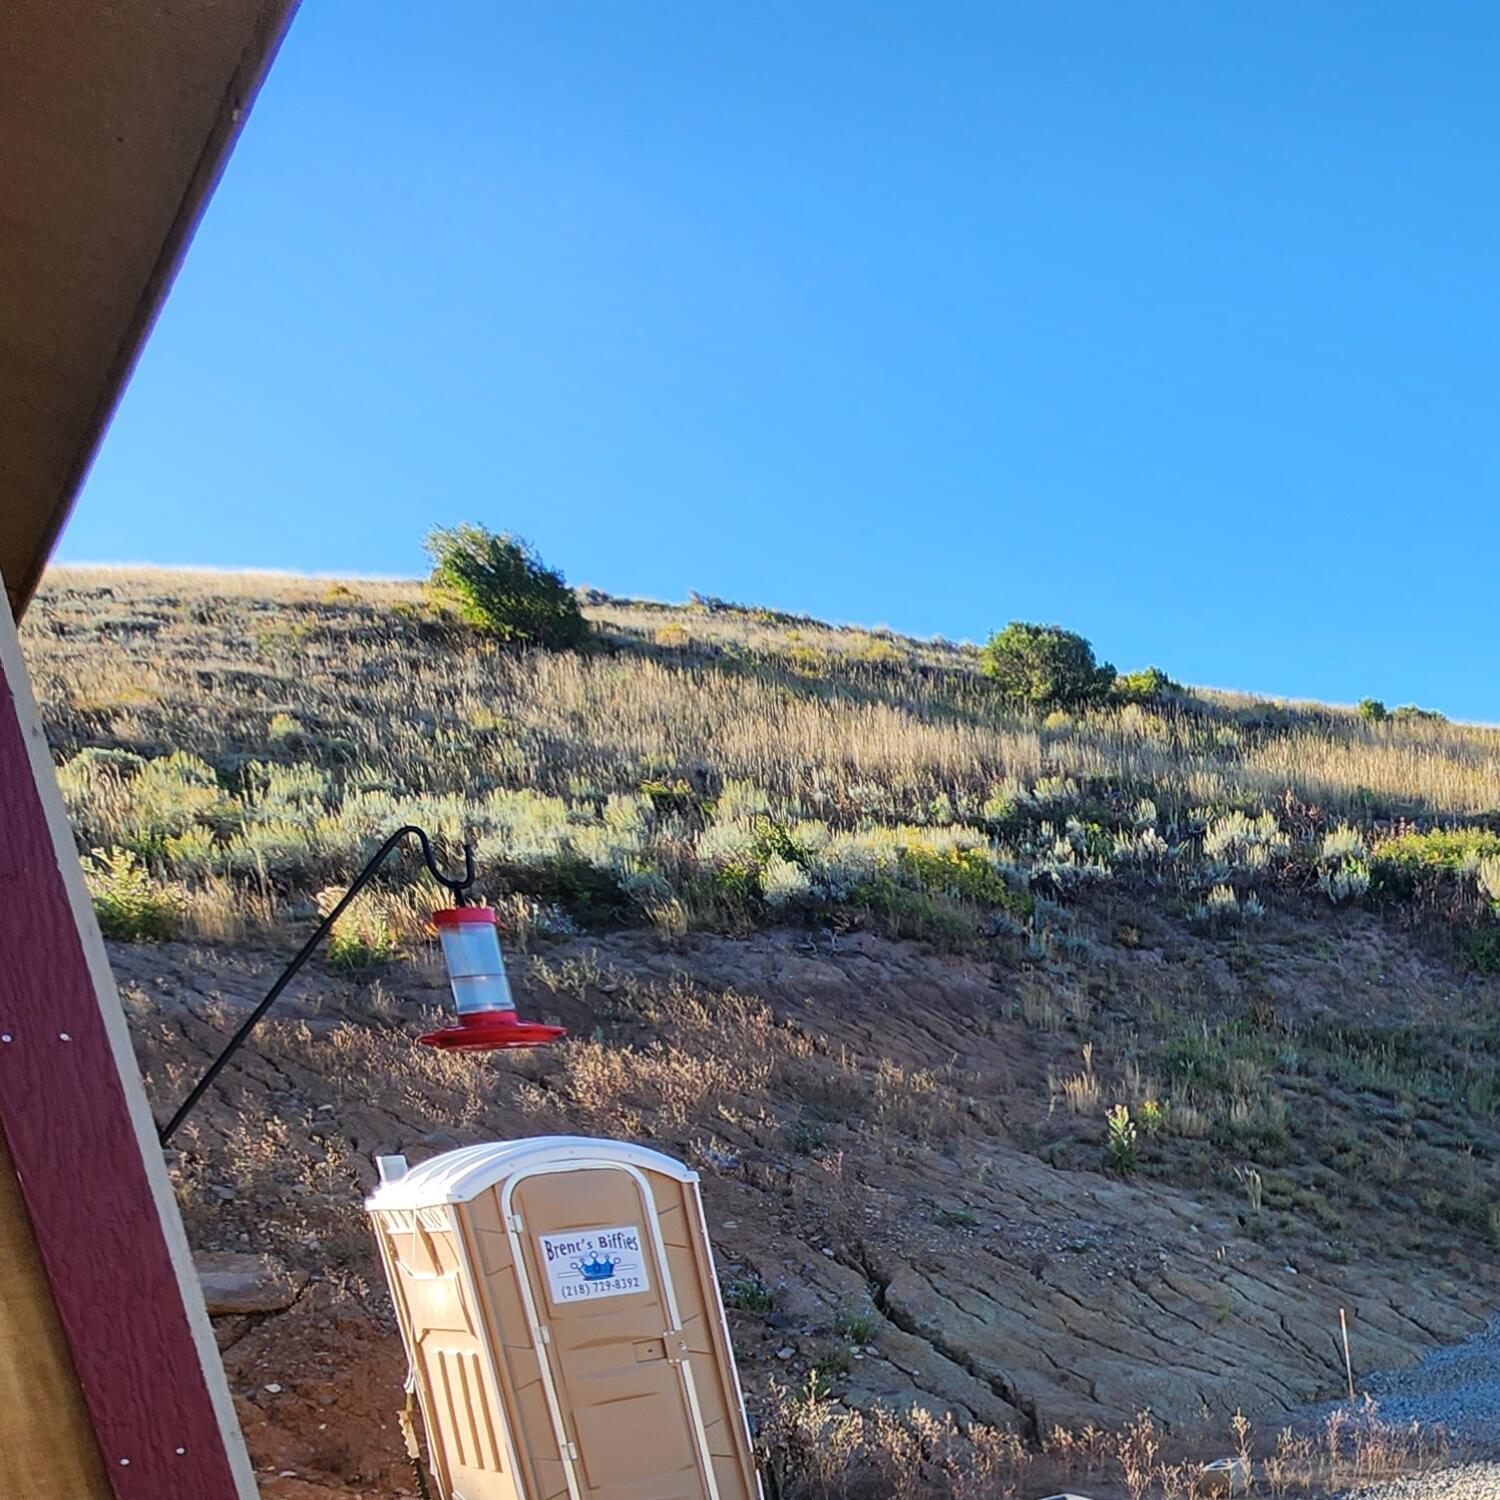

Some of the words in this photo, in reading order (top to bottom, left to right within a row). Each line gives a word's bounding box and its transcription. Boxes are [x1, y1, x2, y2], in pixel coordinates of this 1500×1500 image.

[598, 1232, 639, 1251] Biffies
[561, 1283, 591, 1298] (218)
[593, 1277, 640, 1293] 729-8392
